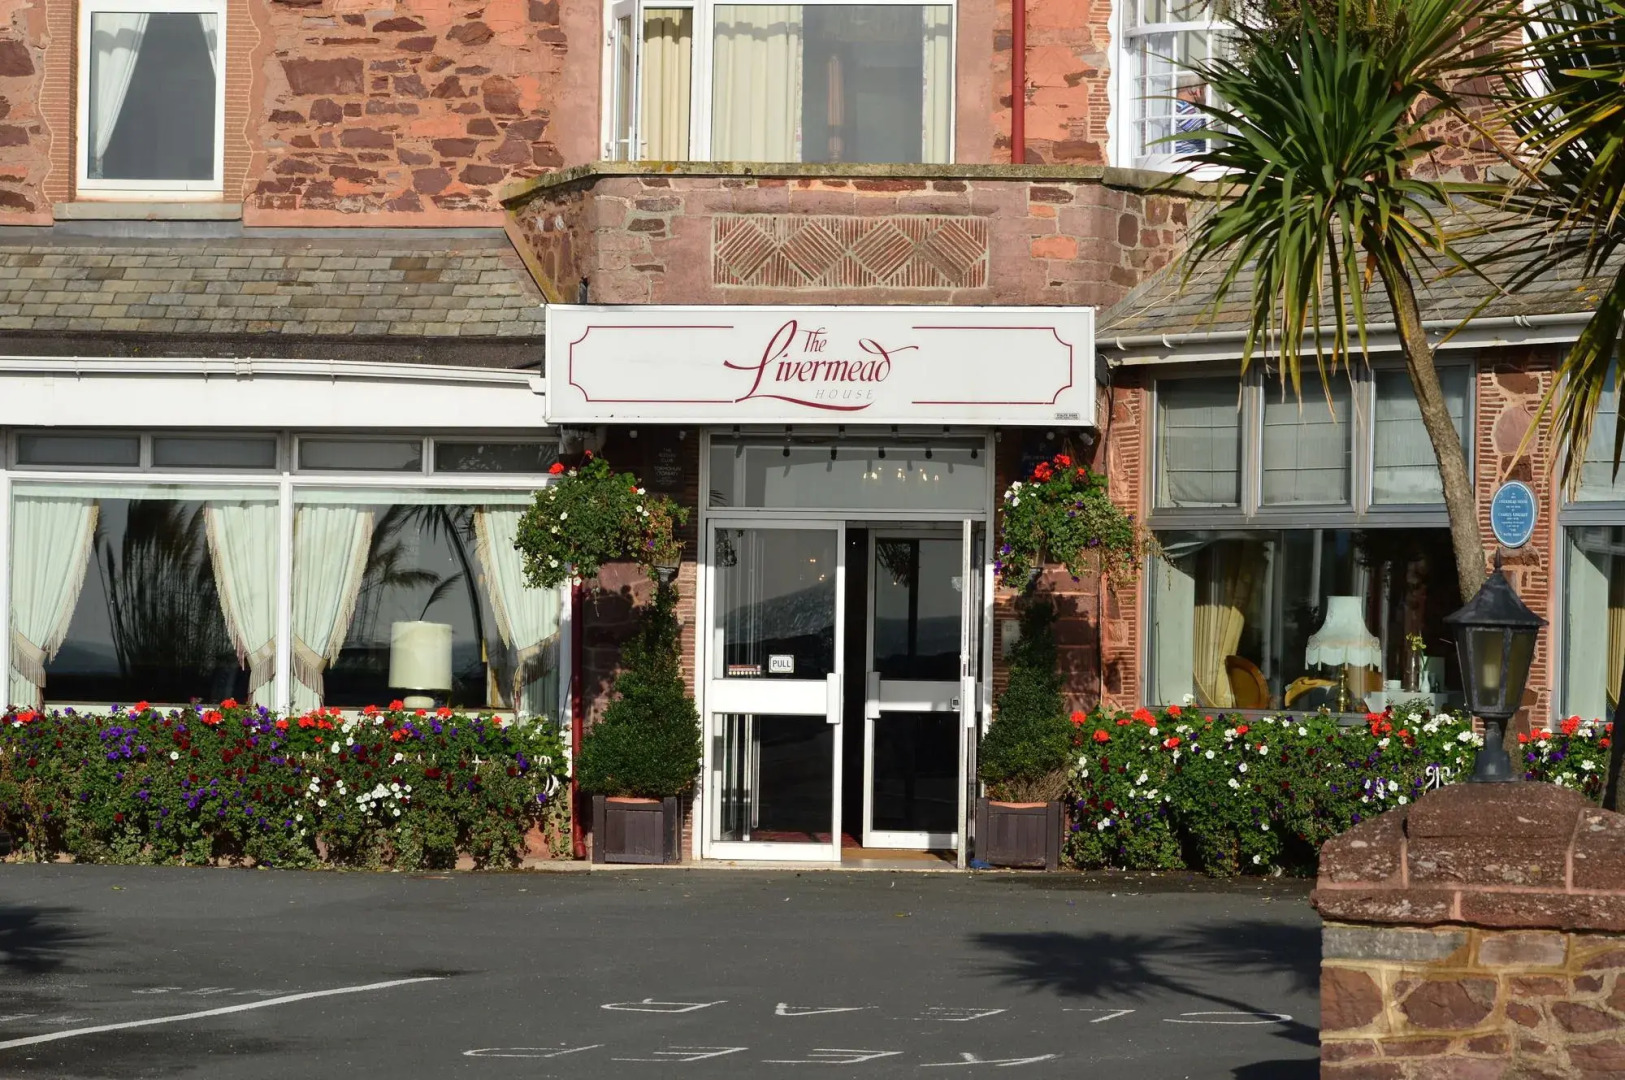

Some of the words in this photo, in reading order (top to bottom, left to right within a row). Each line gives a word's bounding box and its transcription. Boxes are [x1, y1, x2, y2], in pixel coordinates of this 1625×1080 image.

[797, 327, 828, 352] The
[723, 319, 919, 411] Livermead
[815, 389, 873, 399] HOUSE
[462, 1044, 1059, 1067] KEEP
